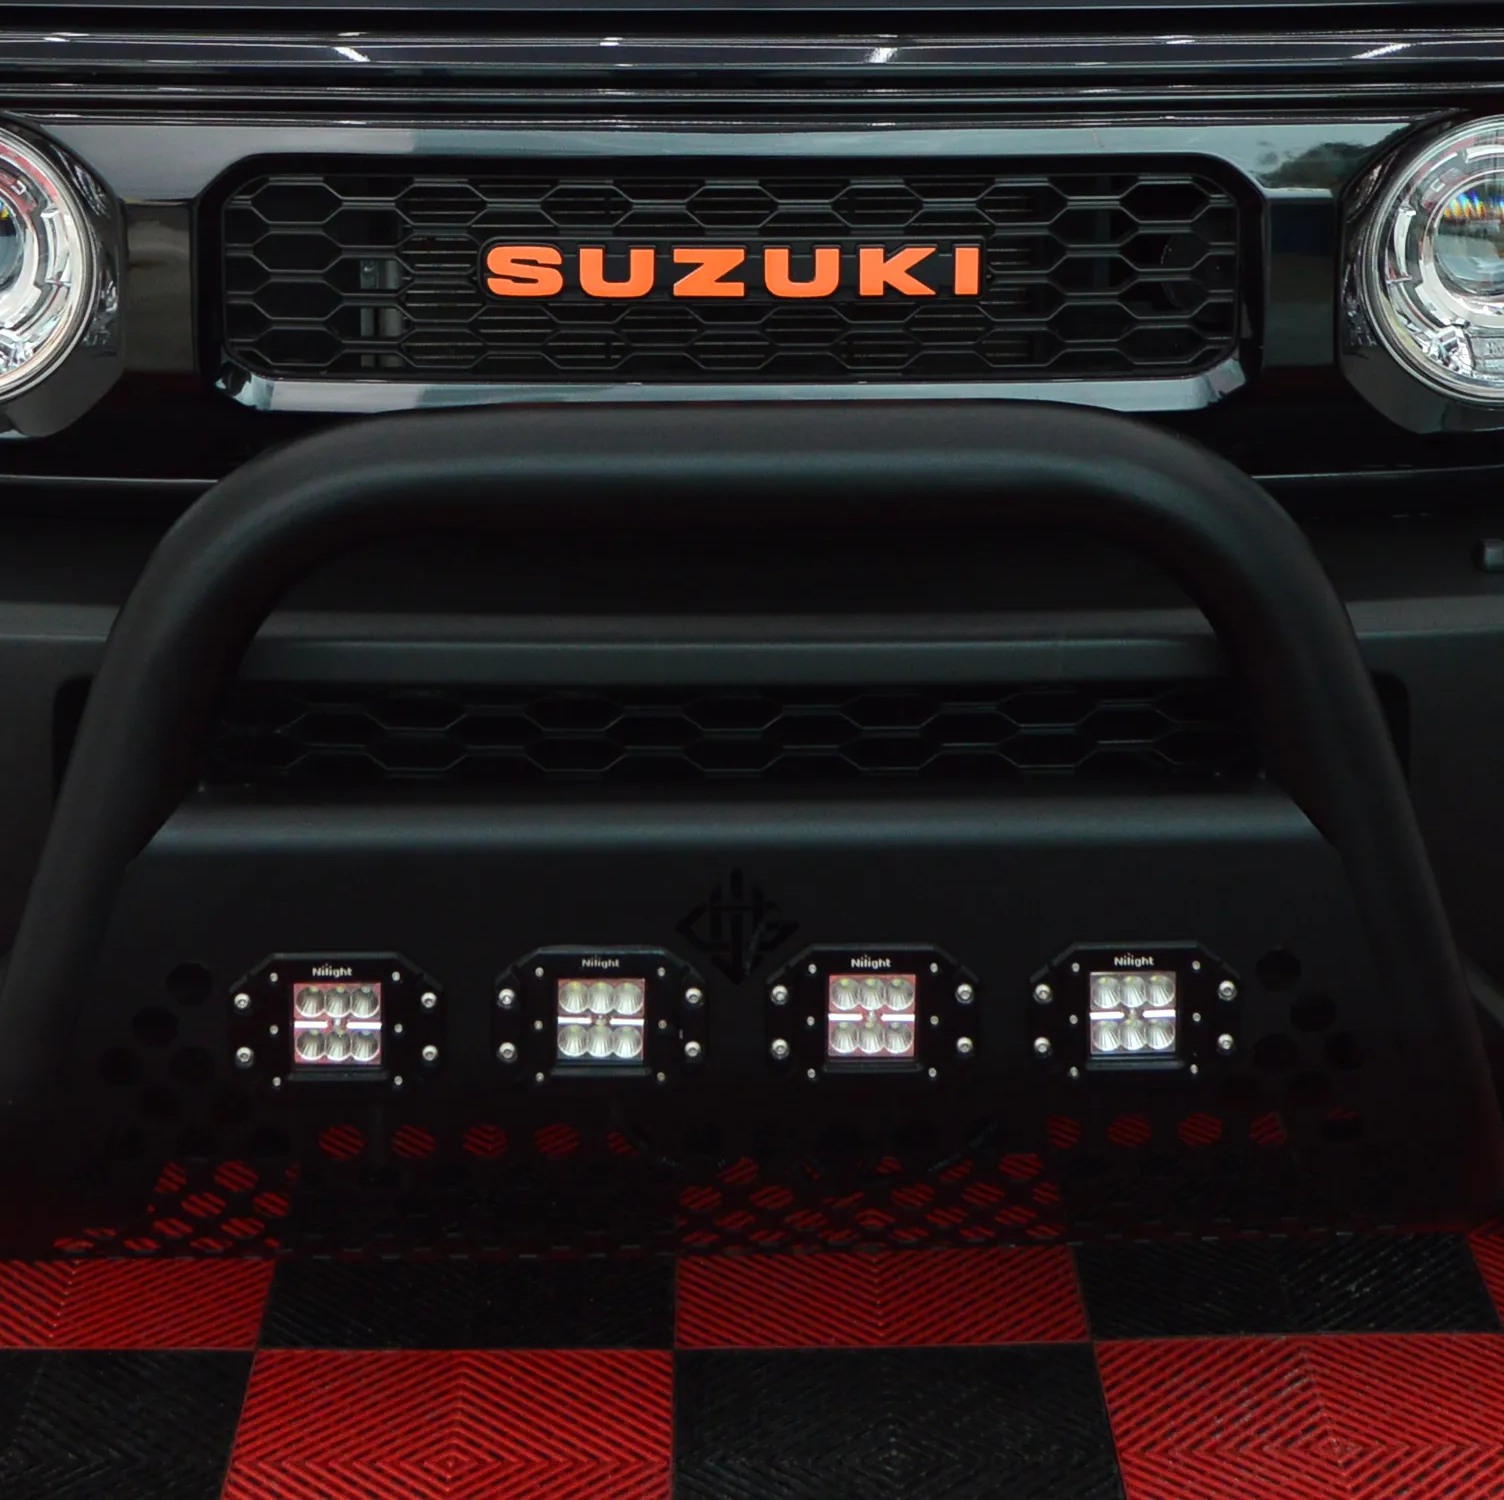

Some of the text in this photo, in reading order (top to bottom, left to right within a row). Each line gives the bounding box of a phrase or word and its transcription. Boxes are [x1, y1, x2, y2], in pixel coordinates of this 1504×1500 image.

[486, 245, 980, 298] SUZUKI
[581, 954, 620, 969] Nilight
[850, 954, 891, 969] Nilight
[1114, 952, 1154, 967] Nilight
[312, 963, 353, 978] Nilight
